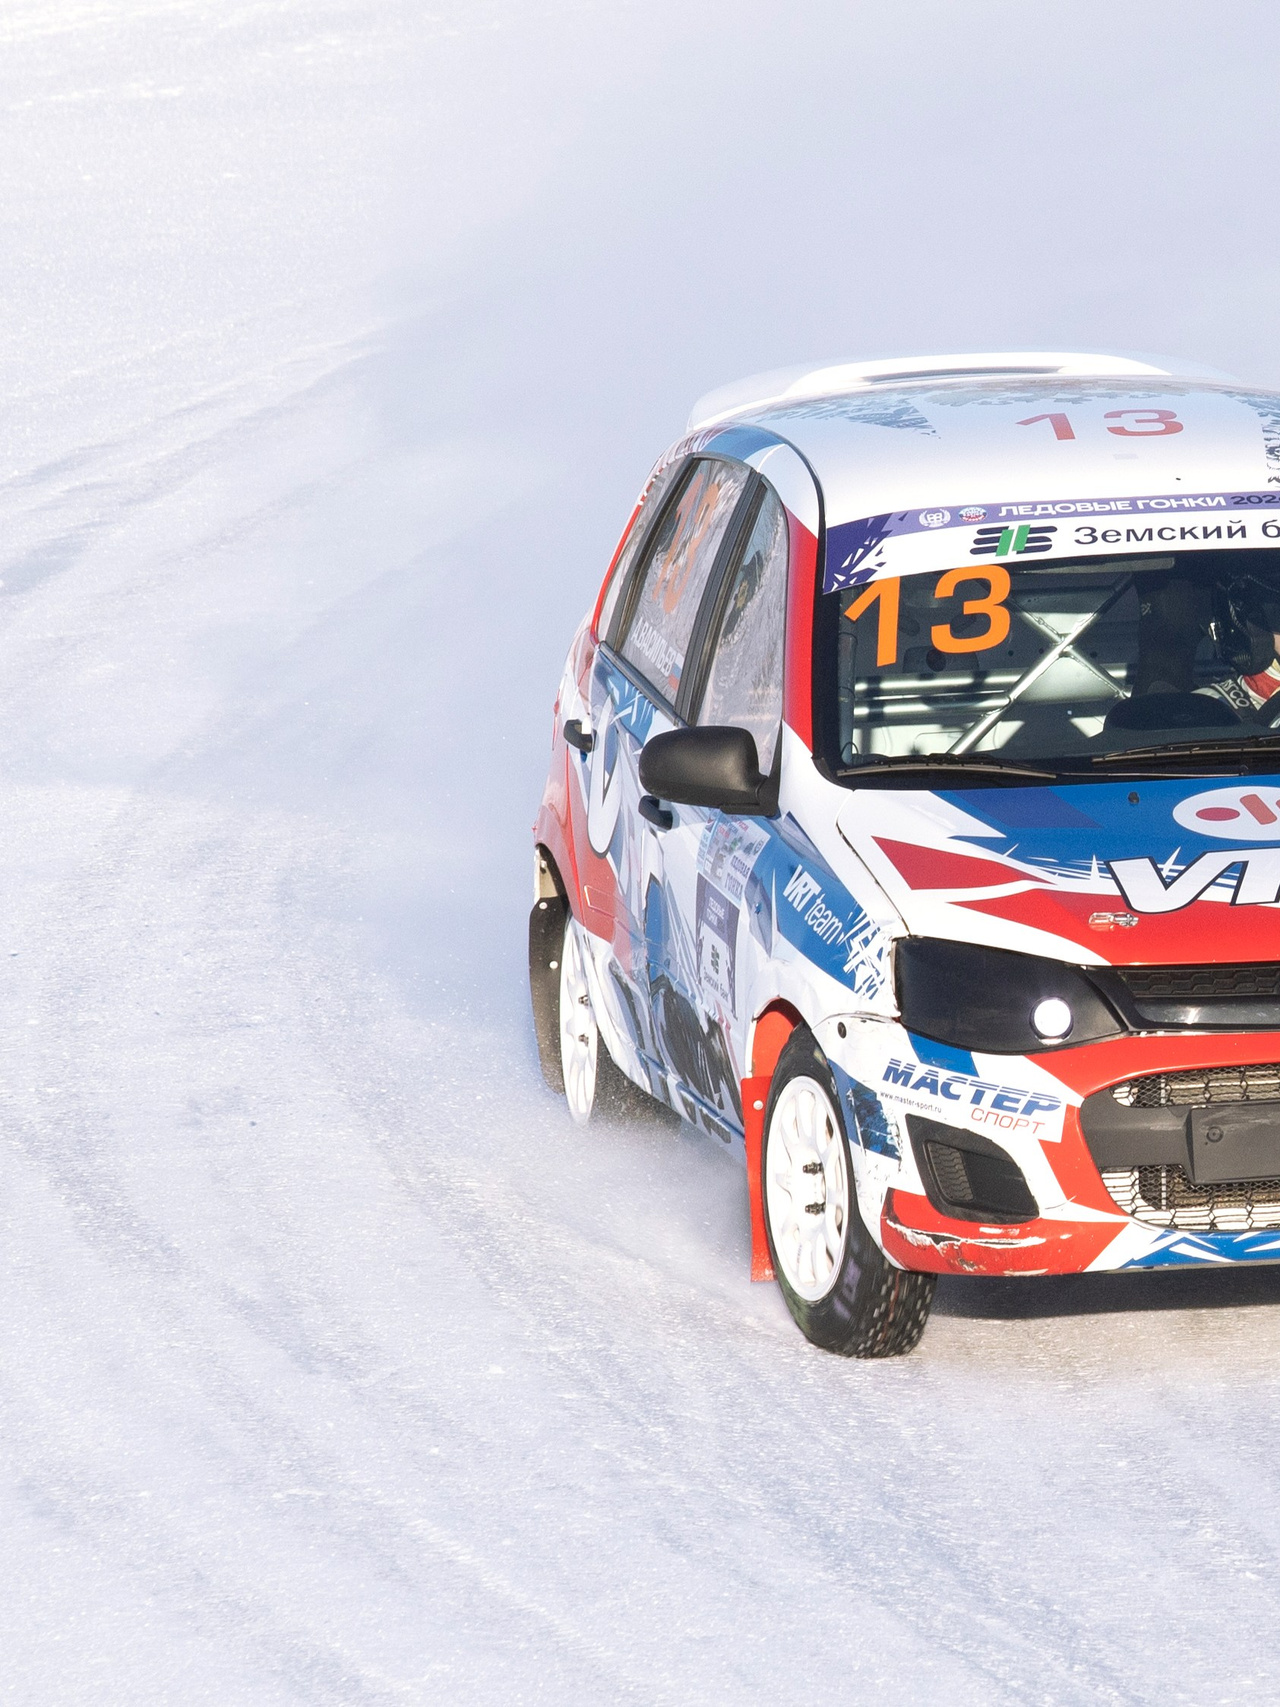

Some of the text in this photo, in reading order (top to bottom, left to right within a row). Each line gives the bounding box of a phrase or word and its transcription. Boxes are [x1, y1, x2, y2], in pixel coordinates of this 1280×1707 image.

[1015, 409, 1184, 441] 13
[999, 499, 1133, 517] ЛЕДОВЫЕ
[1138, 496, 1227, 510] ГОНКИ
[652, 473, 720, 614] 13
[1074, 520, 1247, 544] Земский
[844, 564, 1011, 668] 13
[783, 864, 843, 945] VRT team
[880, 1090, 942, 1114] www.master-sport.ru
[882, 1058, 1062, 1116] МАСТЕР
[970, 1107, 1045, 1135] СПОРТ
